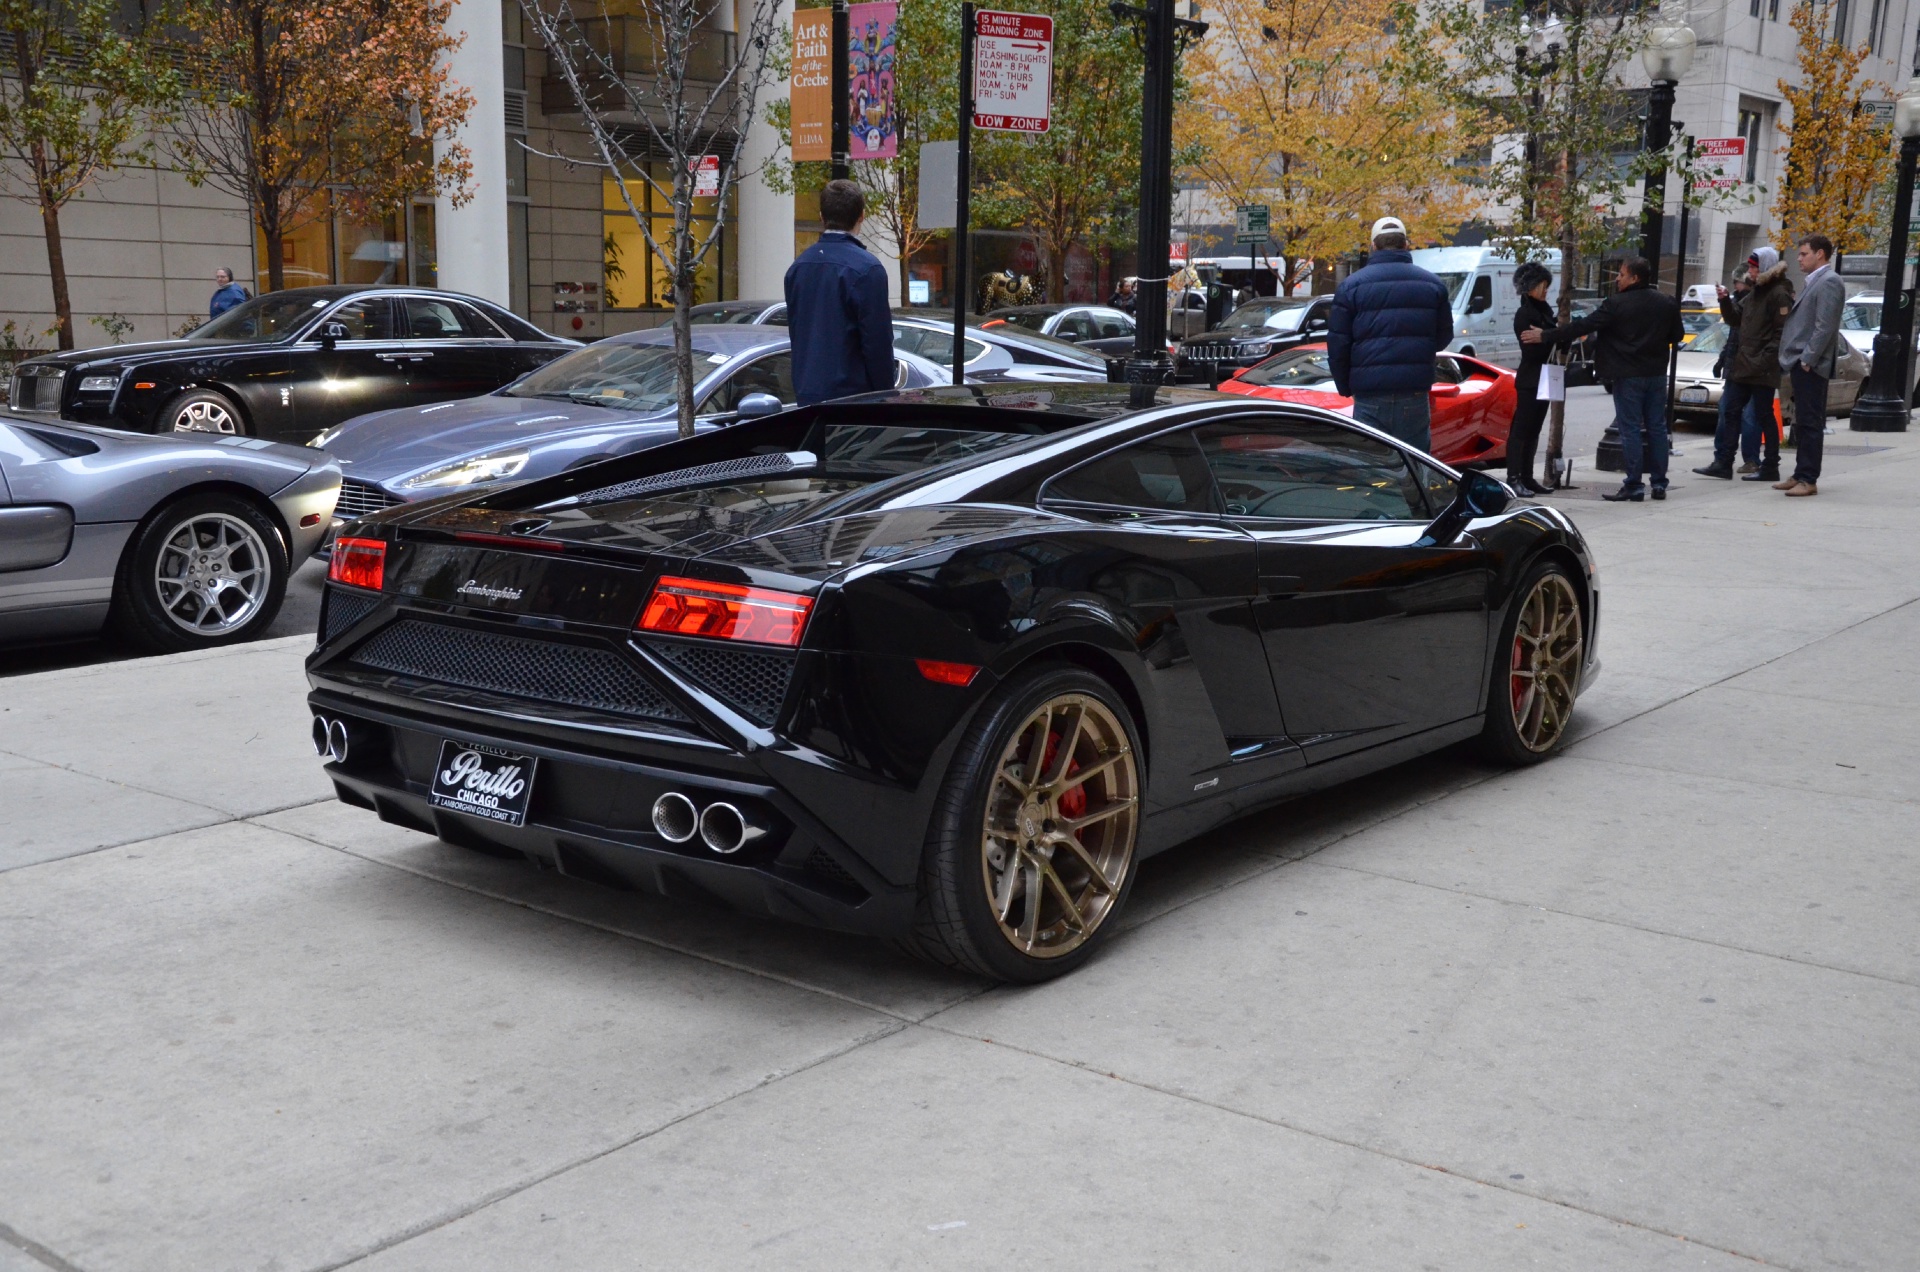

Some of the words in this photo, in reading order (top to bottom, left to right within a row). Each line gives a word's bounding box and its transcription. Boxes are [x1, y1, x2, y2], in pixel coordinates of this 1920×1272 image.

[981, 15, 989, 23] 15
[991, 16, 1021, 26] MINUTE
[795, 23, 817, 40] Art
[819, 24, 828, 37] &
[981, 25, 1019, 36] STANDING
[1023, 28, 1044, 38] ZONE
[795, 40, 827, 58] Faith
[980, 40, 996, 49] USE
[980, 51, 1018, 62] FLASHING
[1020, 54, 1047, 64] LIGHTS
[801, 62, 809, 74] of
[809, 60, 822, 71] the
[1018, 63, 1030, 72] PM
[793, 72, 828, 88] Creche
[980, 70, 997, 79] MON
[1007, 72, 1033, 82] THURS
[1017, 83, 1028, 91] PM
[979, 89, 992, 98] FRI
[1000, 91, 1016, 100] SUN
[978, 115, 1004, 127] TOW
[1010, 117, 1042, 130] ZONE
[799, 134, 823, 144] LUMA
[457, 579, 523, 600] Lamborghini
[441, 750, 525, 799] Perillo
[457, 788, 499, 808] CHICAGO
[440, 798, 477, 813] LAMBORGHINI
[476, 806, 491, 817] GOLD
[491, 810, 509, 821] COAST
